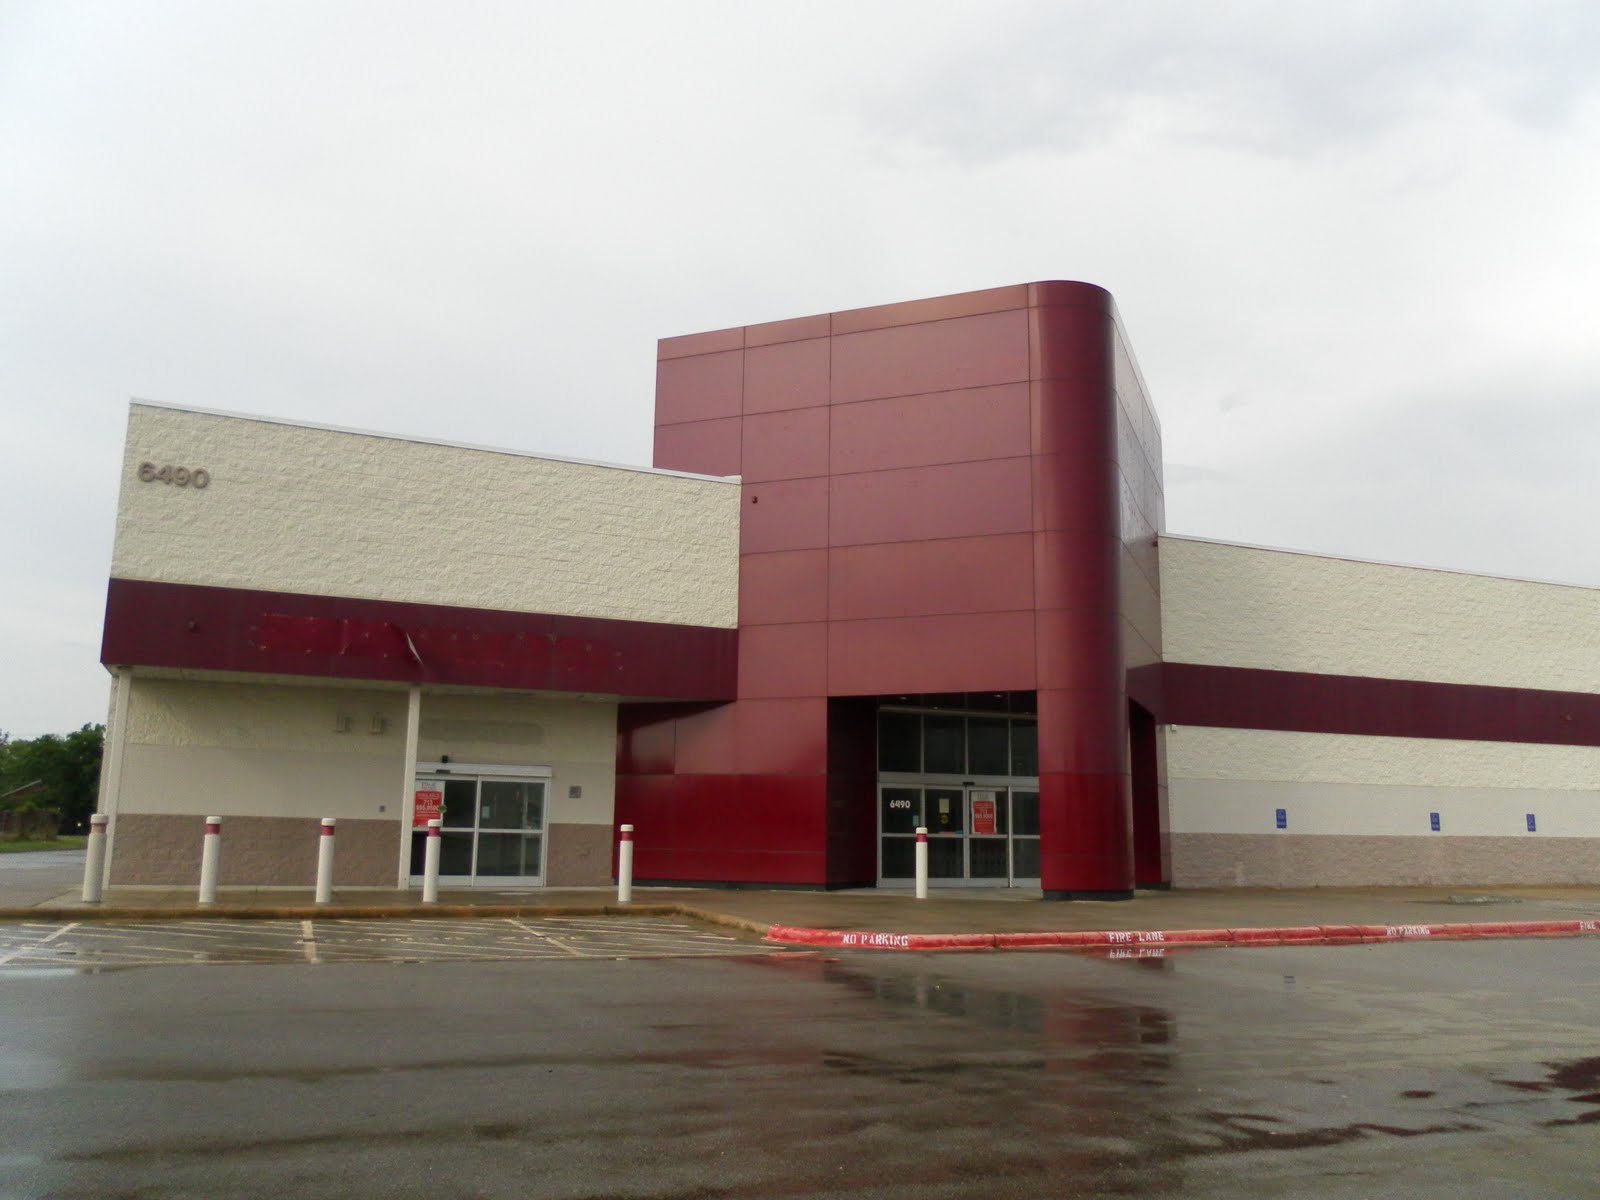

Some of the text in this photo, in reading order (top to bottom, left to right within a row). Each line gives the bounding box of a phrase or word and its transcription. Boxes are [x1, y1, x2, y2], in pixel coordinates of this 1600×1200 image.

[138, 462, 209, 489] 6490
[889, 800, 911, 808] 6490
[1386, 925, 1430, 936] NO PARKING
[843, 933, 909, 946] NO PARKING
[1108, 931, 1164, 943] FIRE LANE
